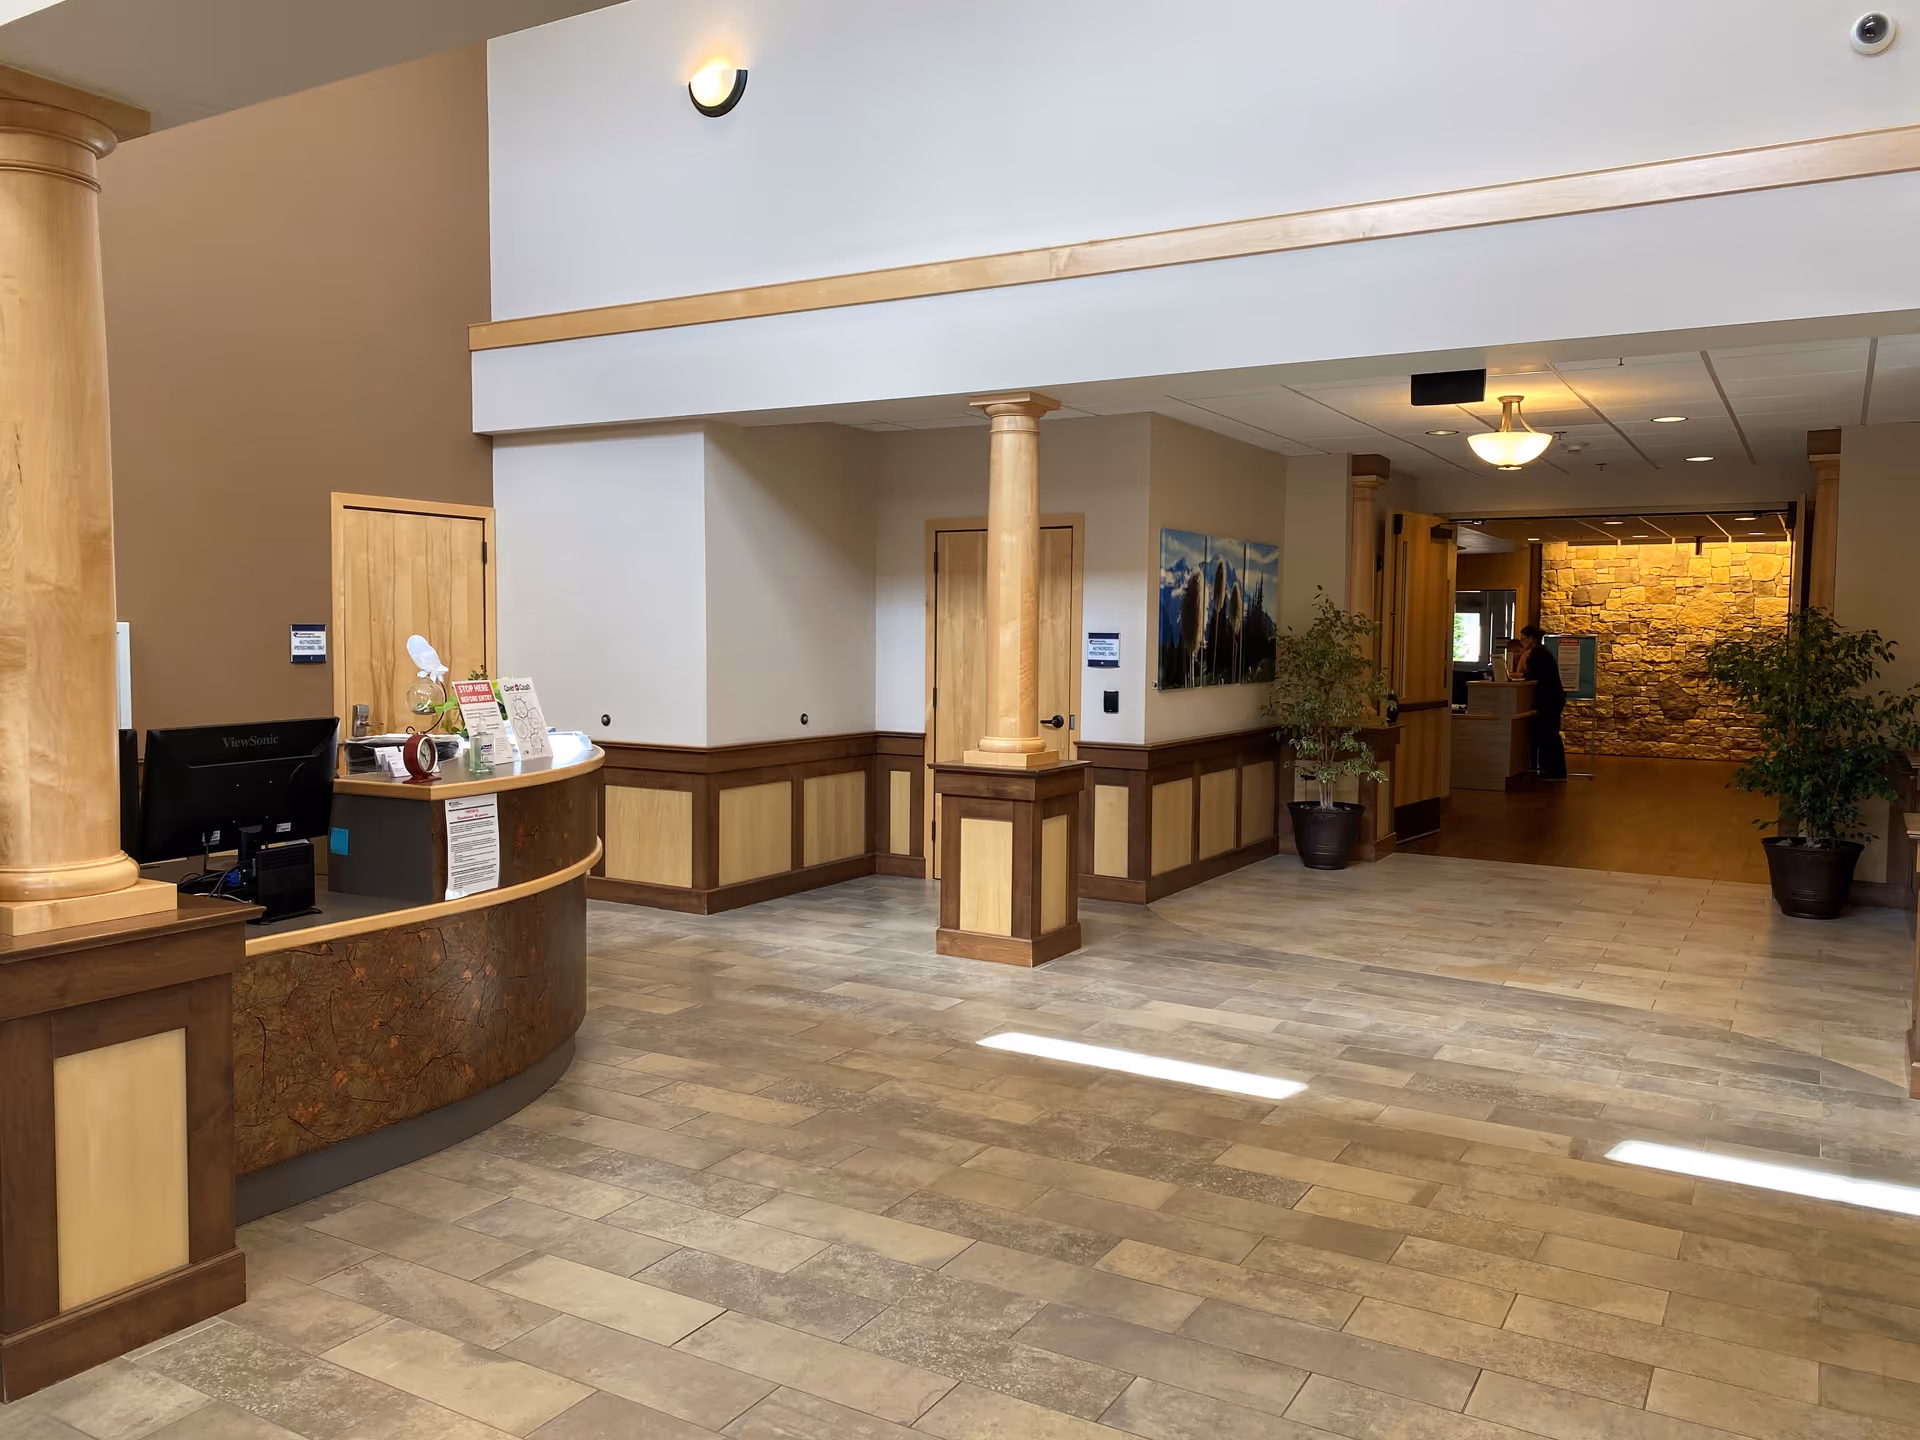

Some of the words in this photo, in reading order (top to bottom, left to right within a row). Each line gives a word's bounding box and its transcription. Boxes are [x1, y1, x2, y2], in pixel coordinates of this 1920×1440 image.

[458, 684, 474, 694] STOP
[474, 683, 490, 693] HERE
[460, 695, 478, 704] BEFORE
[478, 694, 493, 702] ENTRY
[222, 734, 279, 748] ViewSonic
